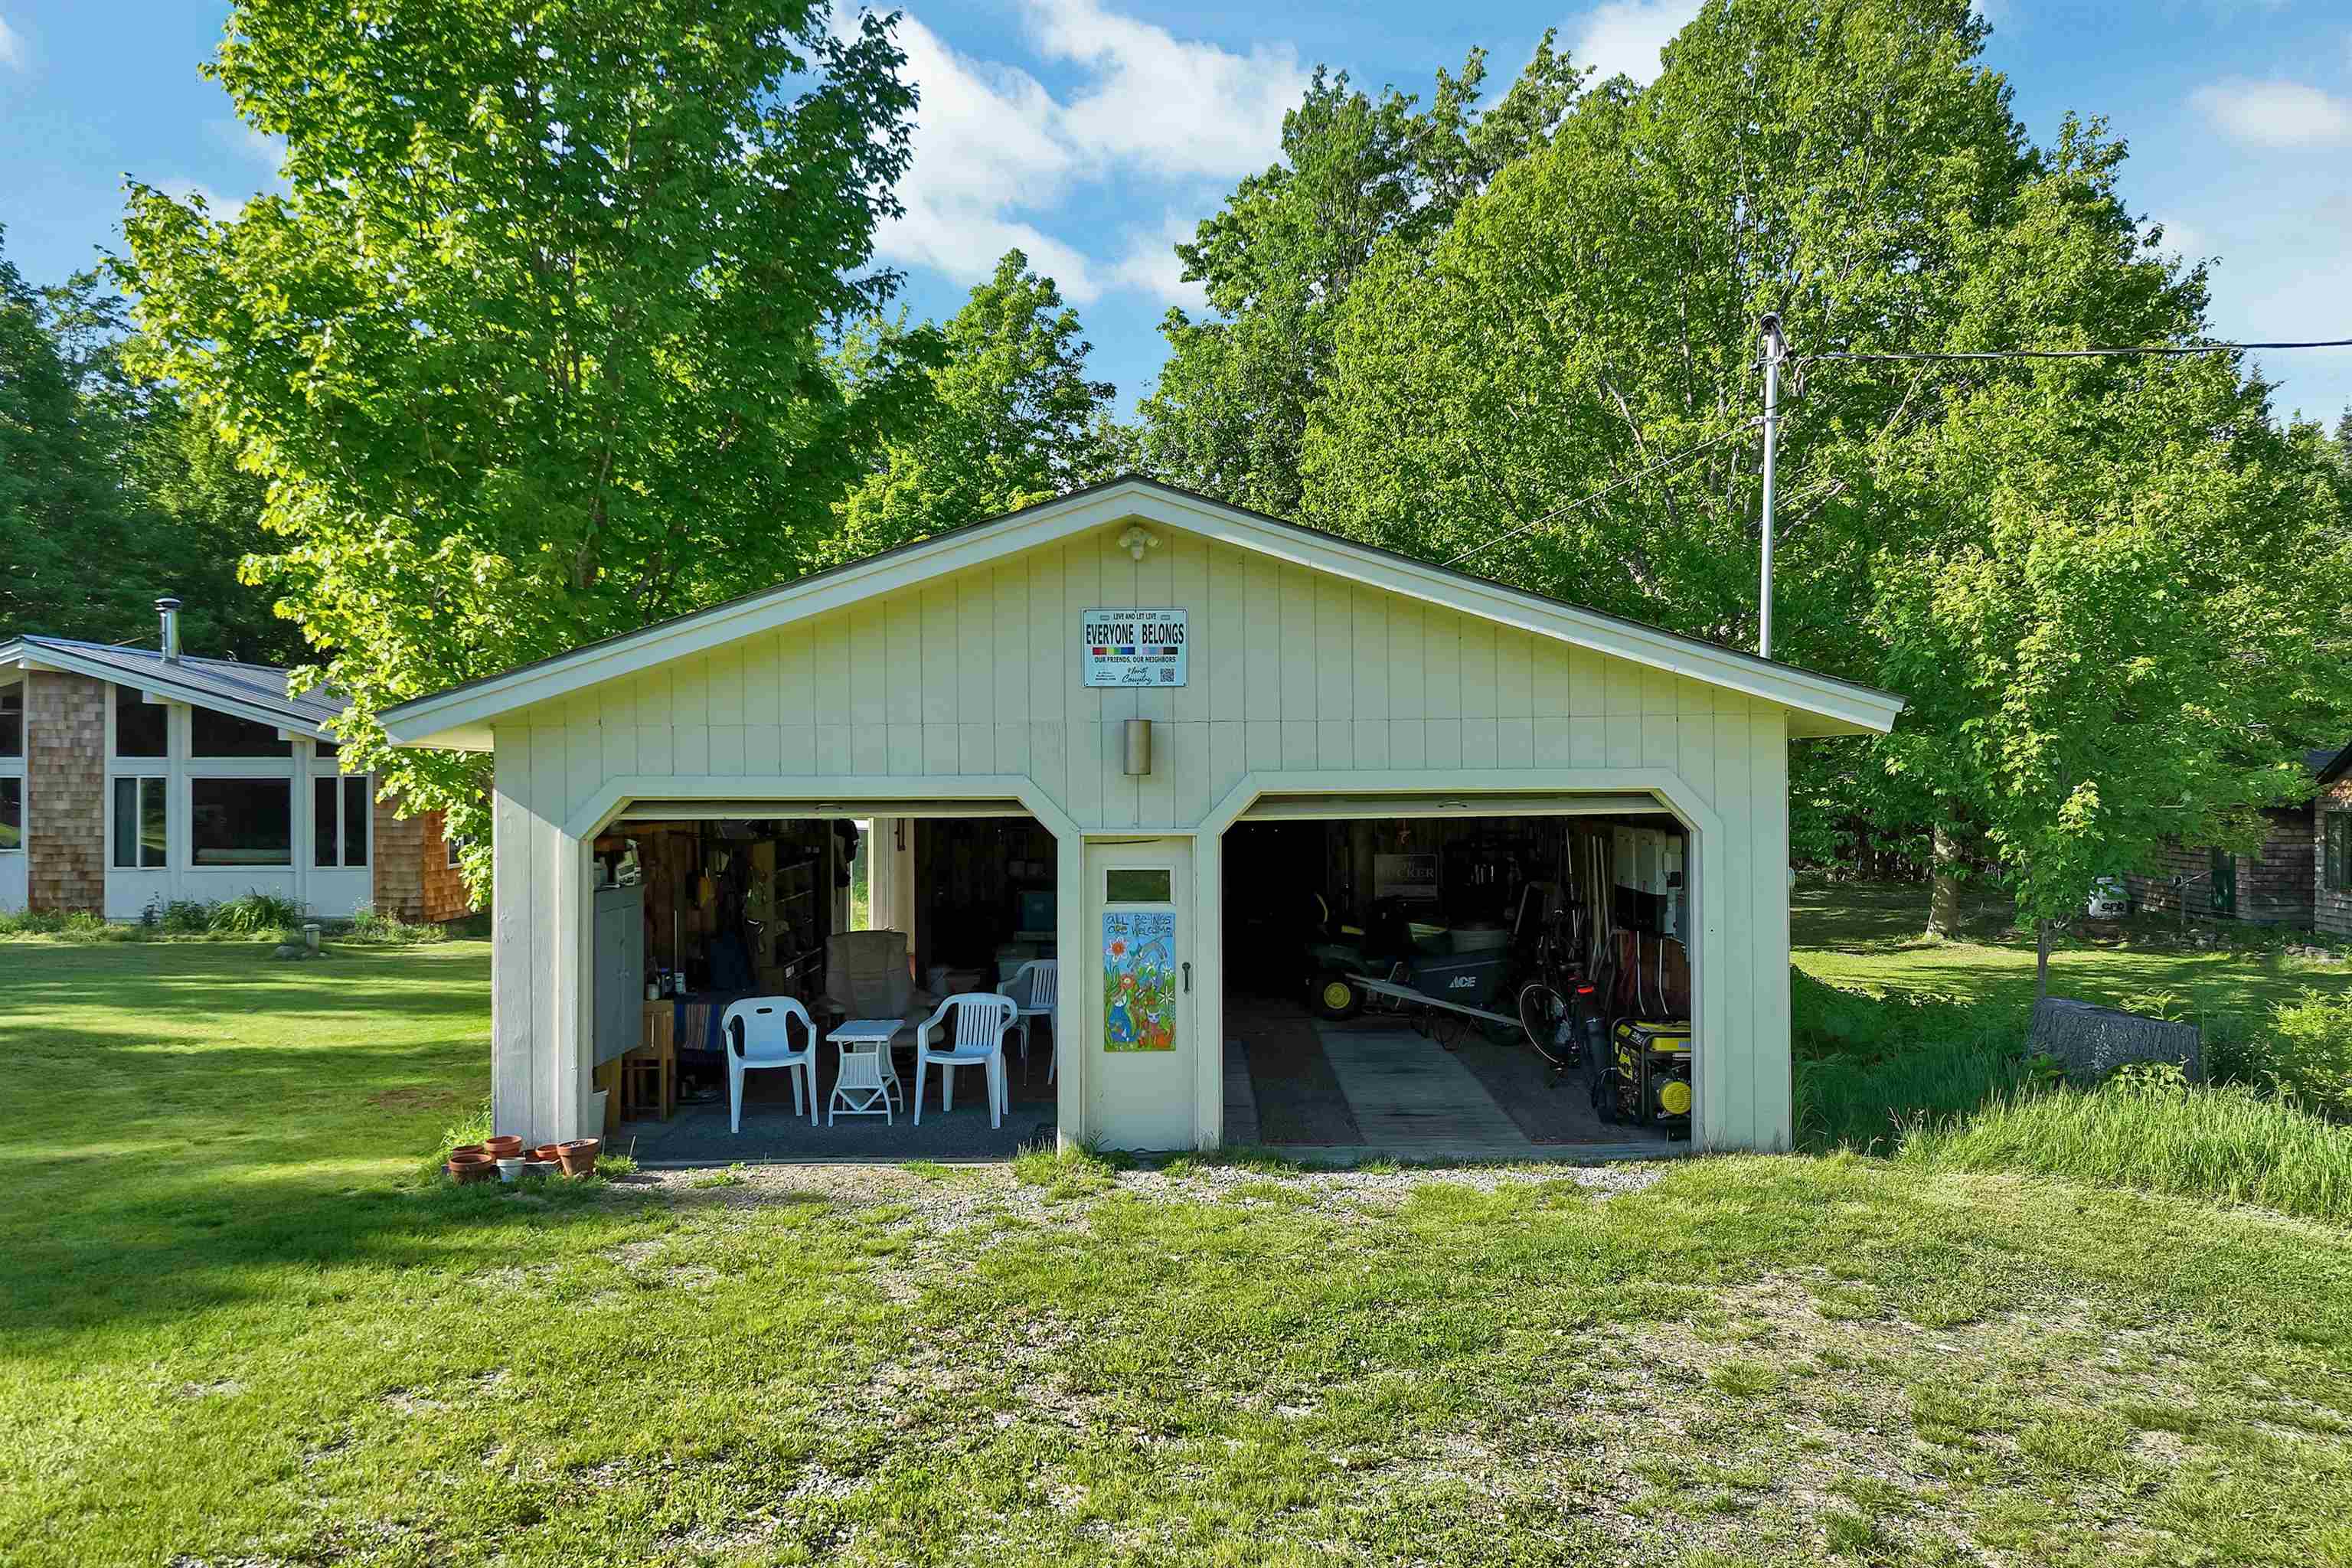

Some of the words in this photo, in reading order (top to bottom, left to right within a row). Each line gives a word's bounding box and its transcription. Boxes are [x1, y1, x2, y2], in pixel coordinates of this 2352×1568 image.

[1086, 623, 1134, 645] EVERYONE
[1142, 623, 1184, 645] BELONGS
[1122, 673, 1152, 685] Country
[1448, 975, 1477, 988] ACE
